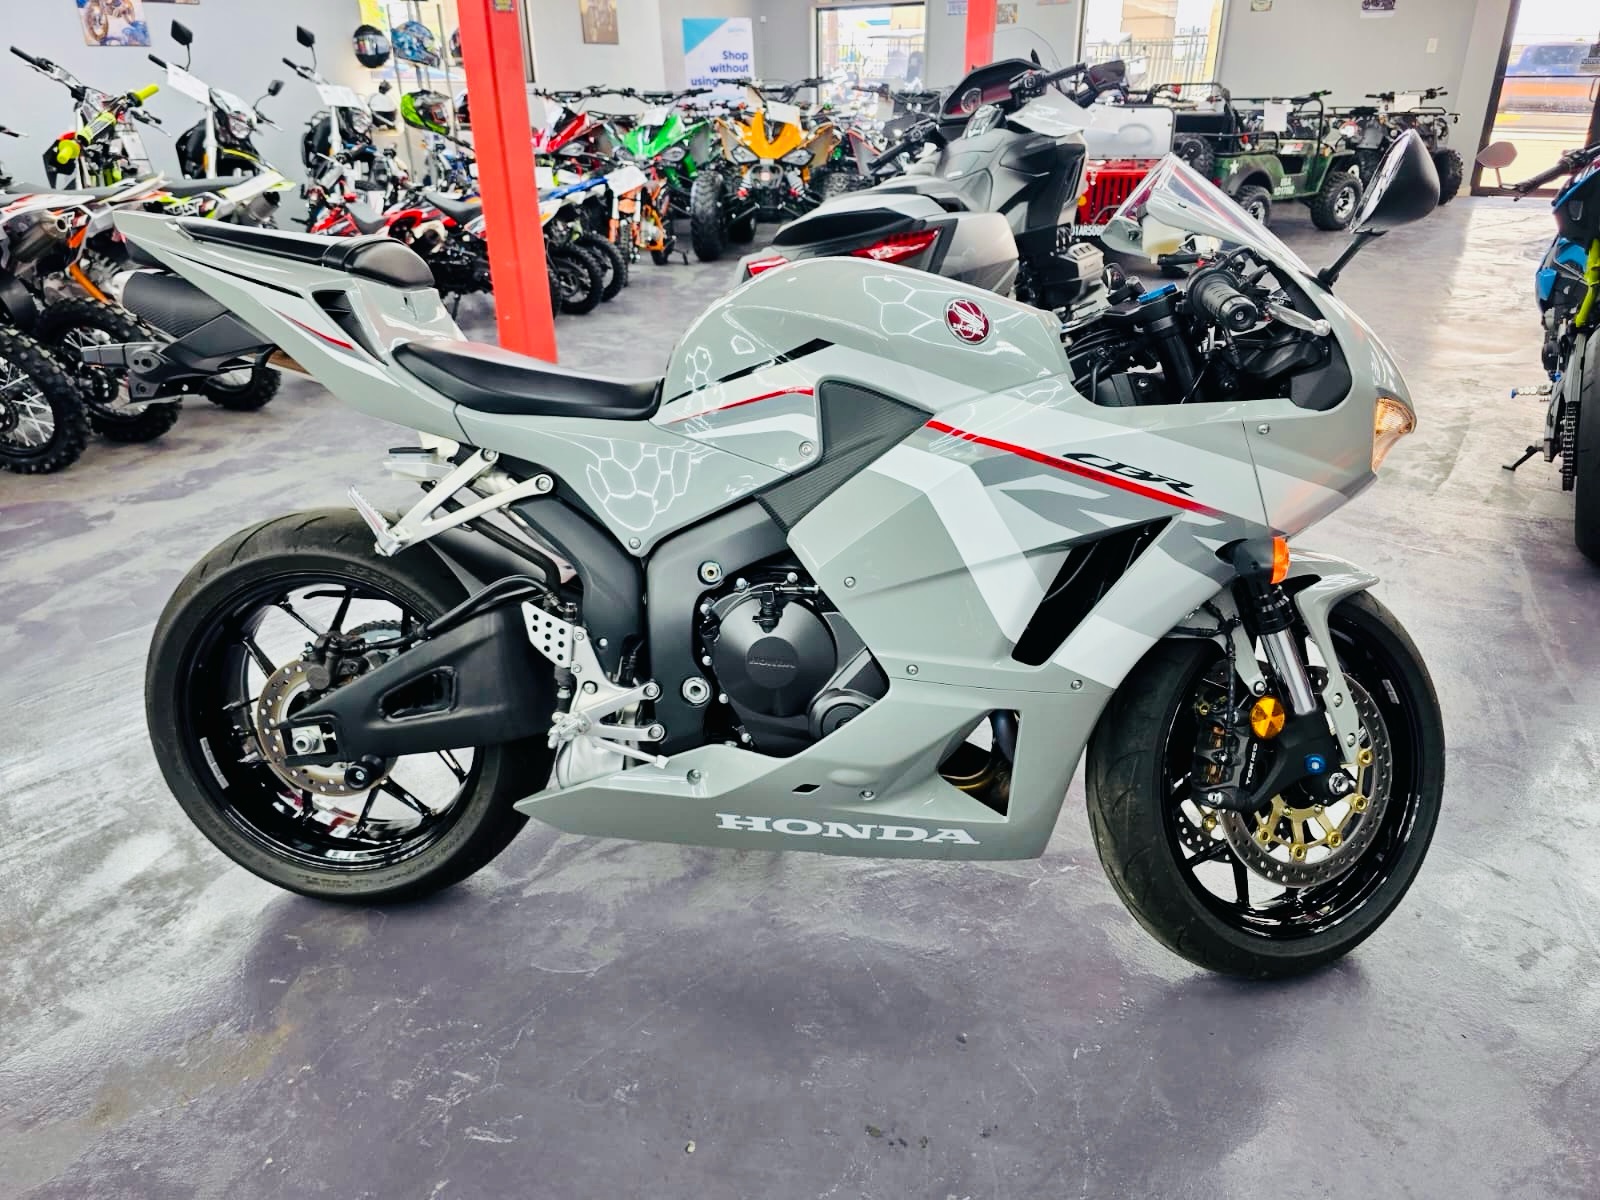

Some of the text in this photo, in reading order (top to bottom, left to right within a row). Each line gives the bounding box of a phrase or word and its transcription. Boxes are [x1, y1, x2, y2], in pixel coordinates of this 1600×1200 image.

[722, 50, 749, 61] Shop
[710, 64, 749, 73] without
[691, 76, 719, 87] using
[1062, 453, 1194, 498] CBR
[715, 813, 981, 845] HONDA
